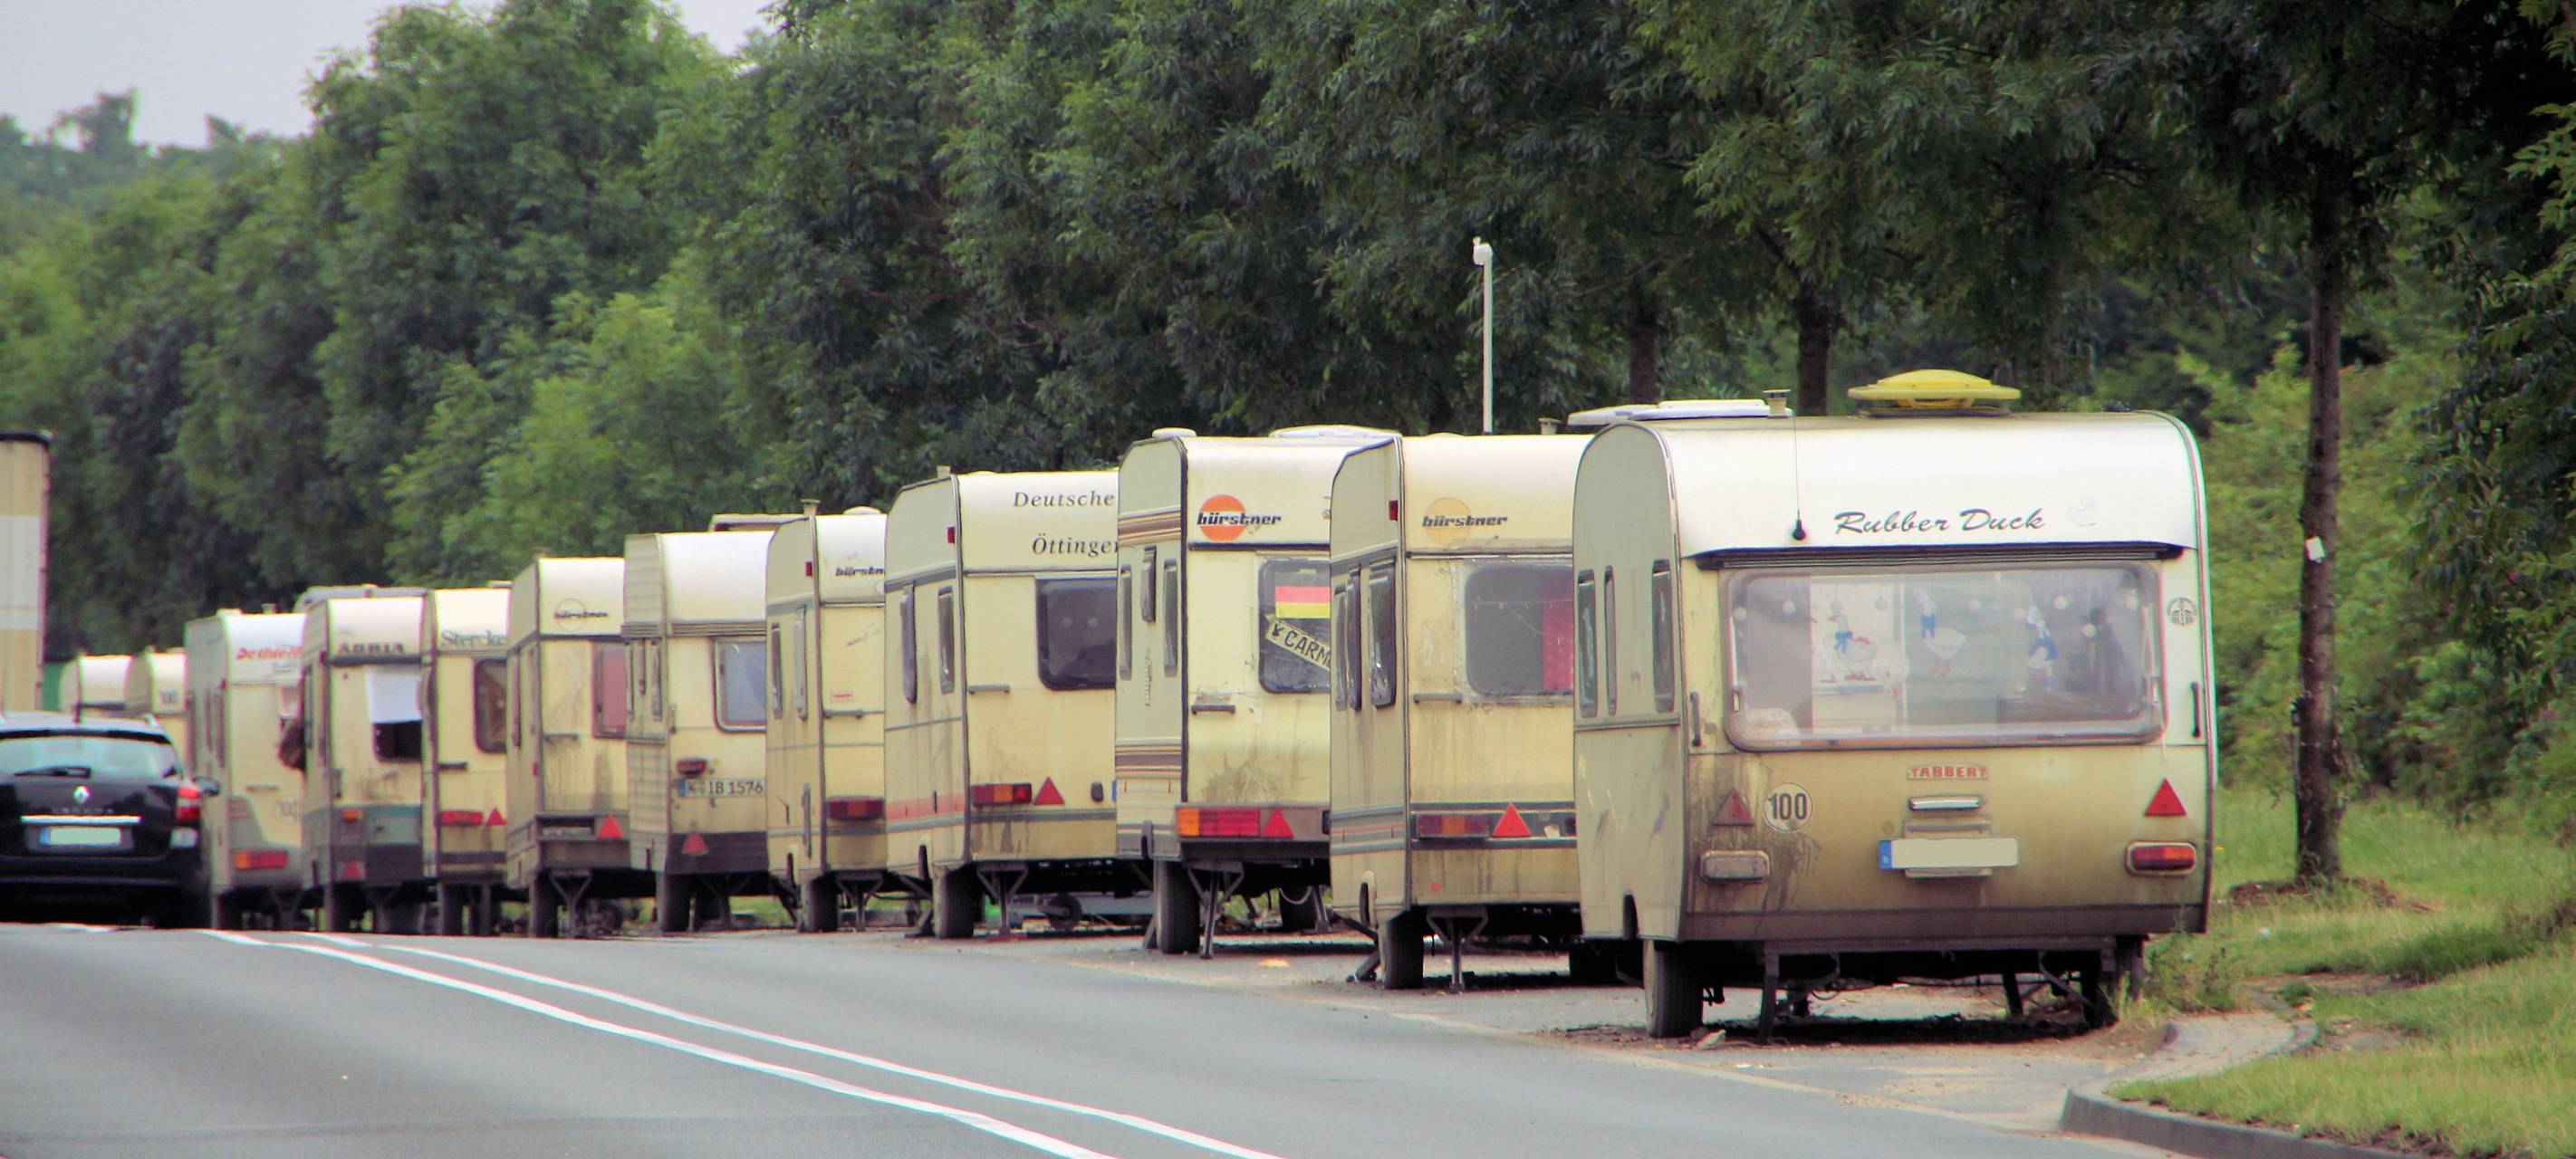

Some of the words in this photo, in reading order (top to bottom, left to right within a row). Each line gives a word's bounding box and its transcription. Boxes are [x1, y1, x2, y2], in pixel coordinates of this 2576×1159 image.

[1013, 490, 1116, 507] Deutsche
[1197, 512, 1282, 526] bürstner
[1421, 515, 1508, 528] bürstner
[1833, 510, 1949, 535] Rubber
[1959, 508, 2045, 532] Duck
[1911, 765, 1988, 780] TABBERT
[727, 781, 763, 794] 1576
[1767, 792, 1808, 820] 100
